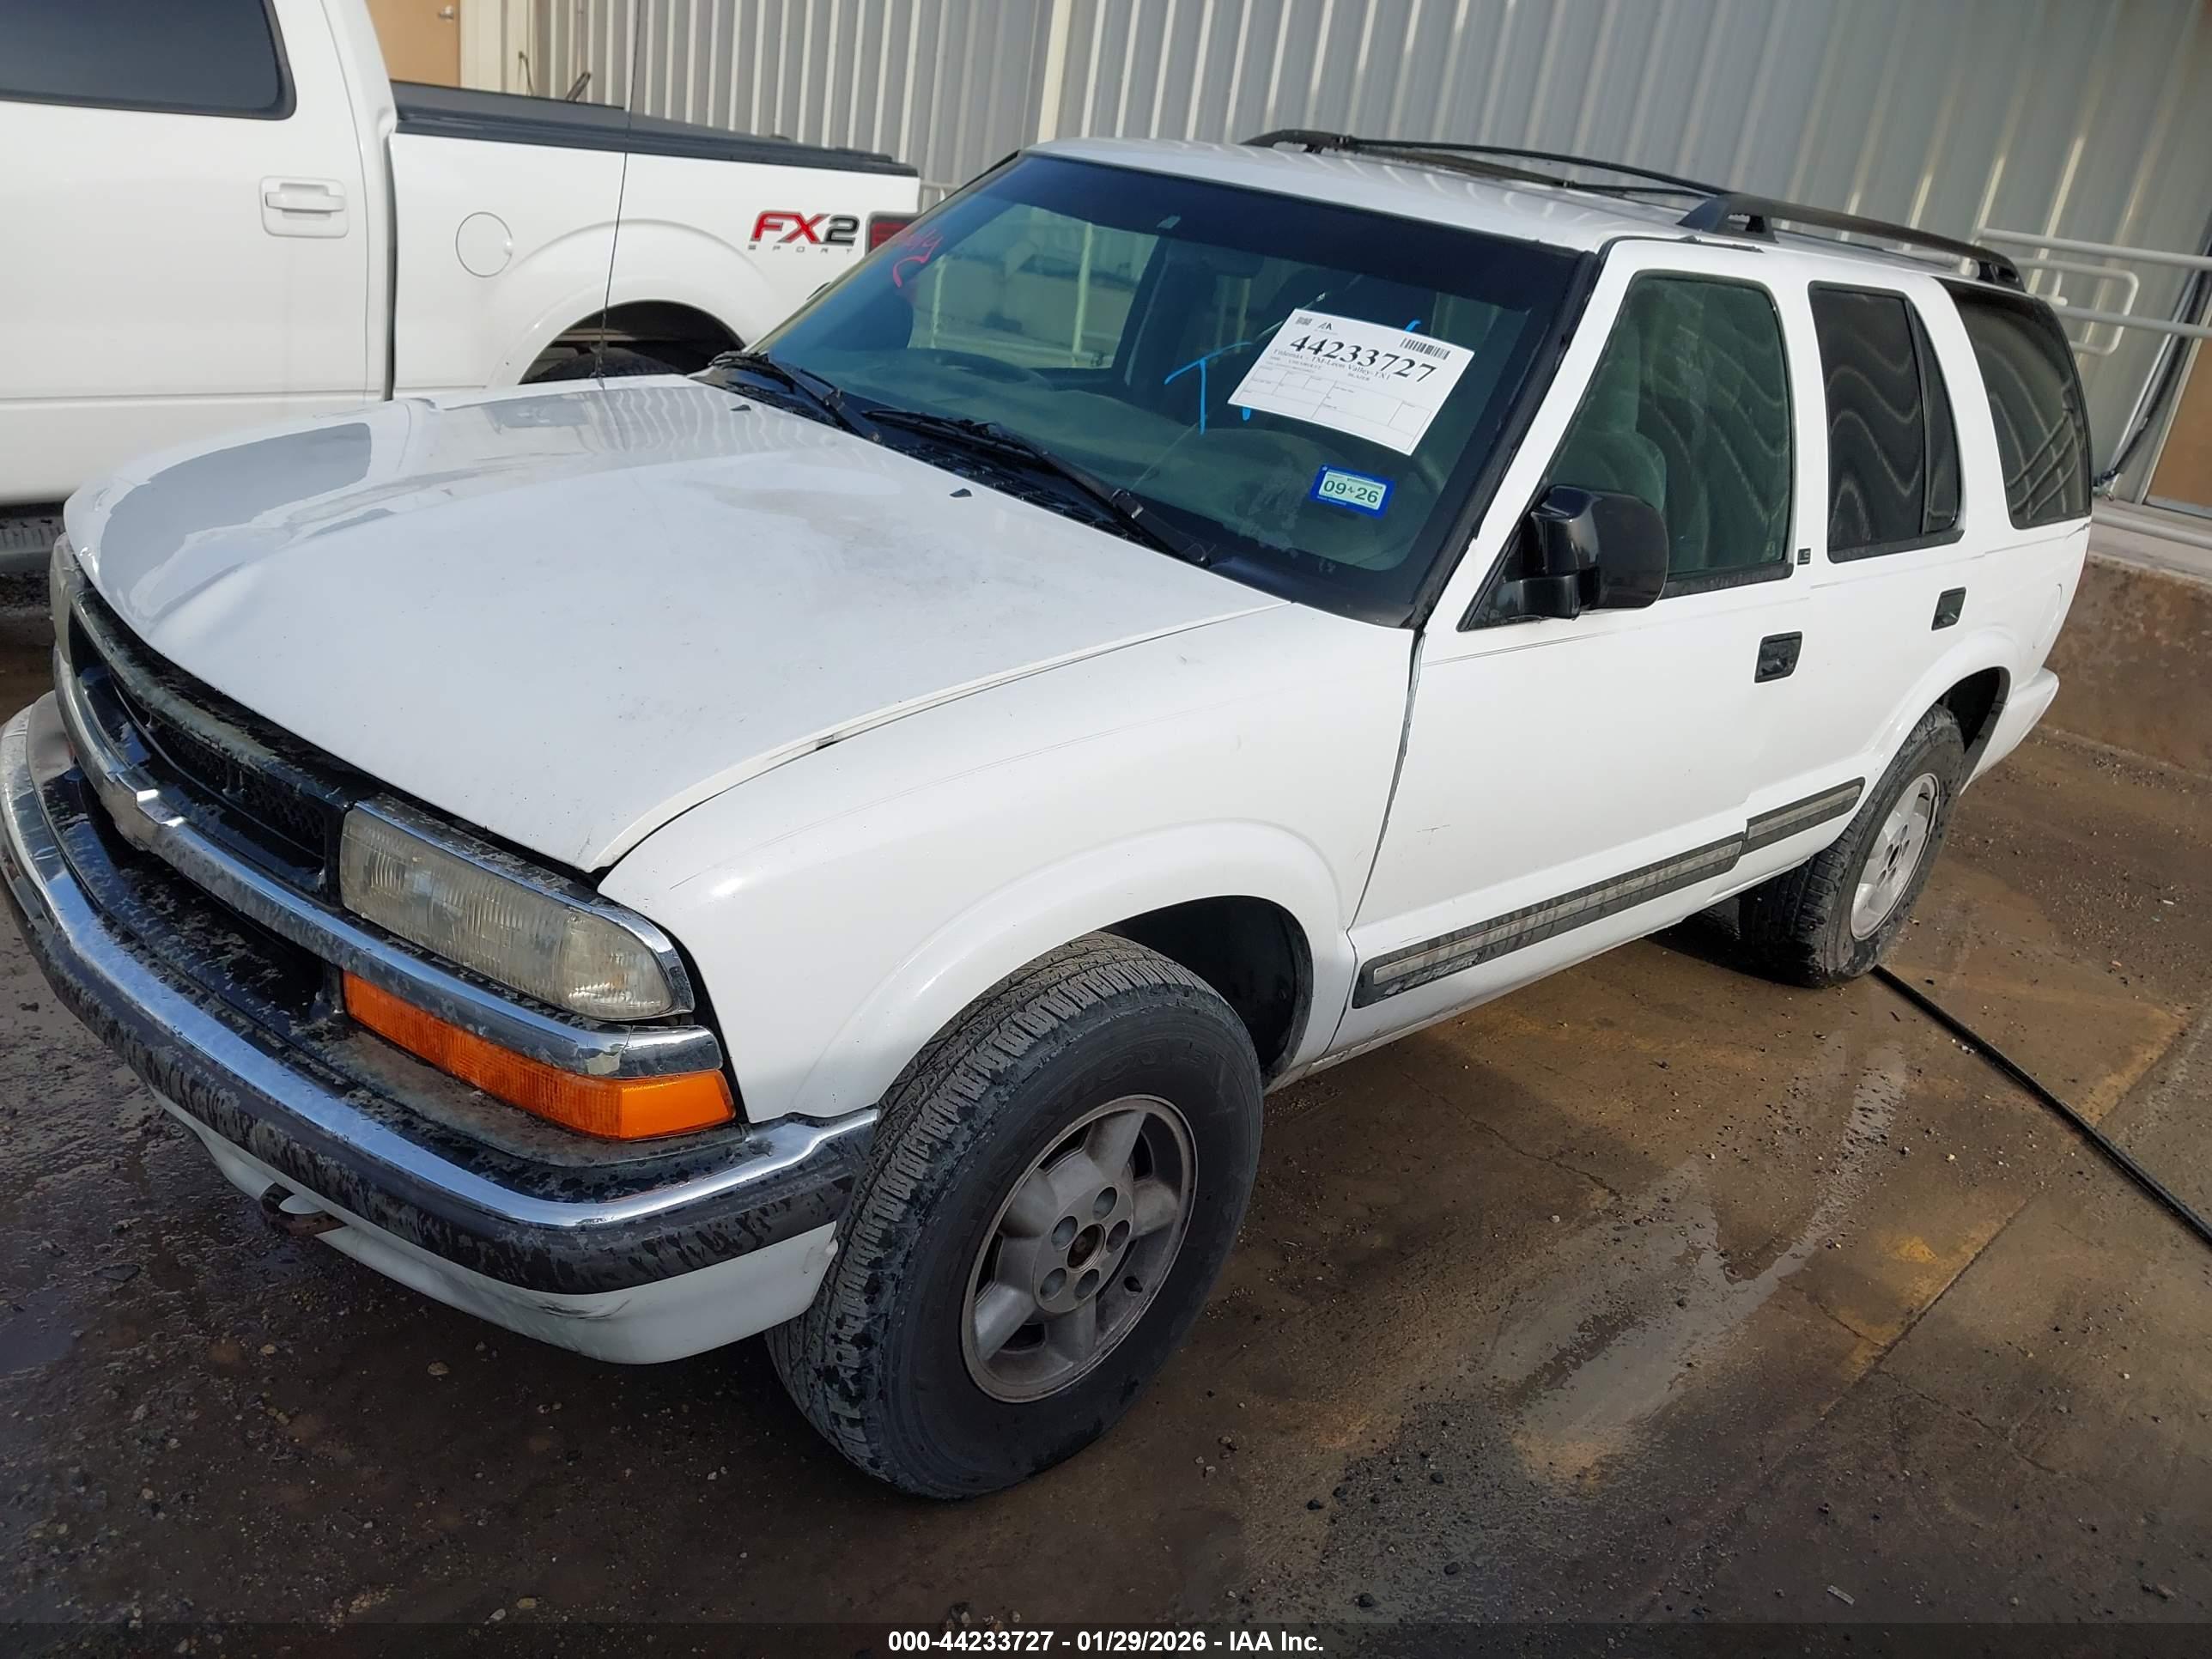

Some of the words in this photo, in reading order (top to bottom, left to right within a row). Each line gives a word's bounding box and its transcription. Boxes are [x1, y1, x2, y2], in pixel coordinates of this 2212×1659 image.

[750, 210, 860, 247] FX2
[748, 244, 853, 255] SPORT
[1290, 335, 1437, 383] 44233727
[1323, 479, 1346, 495] 09
[1354, 487, 1379, 503] 26
